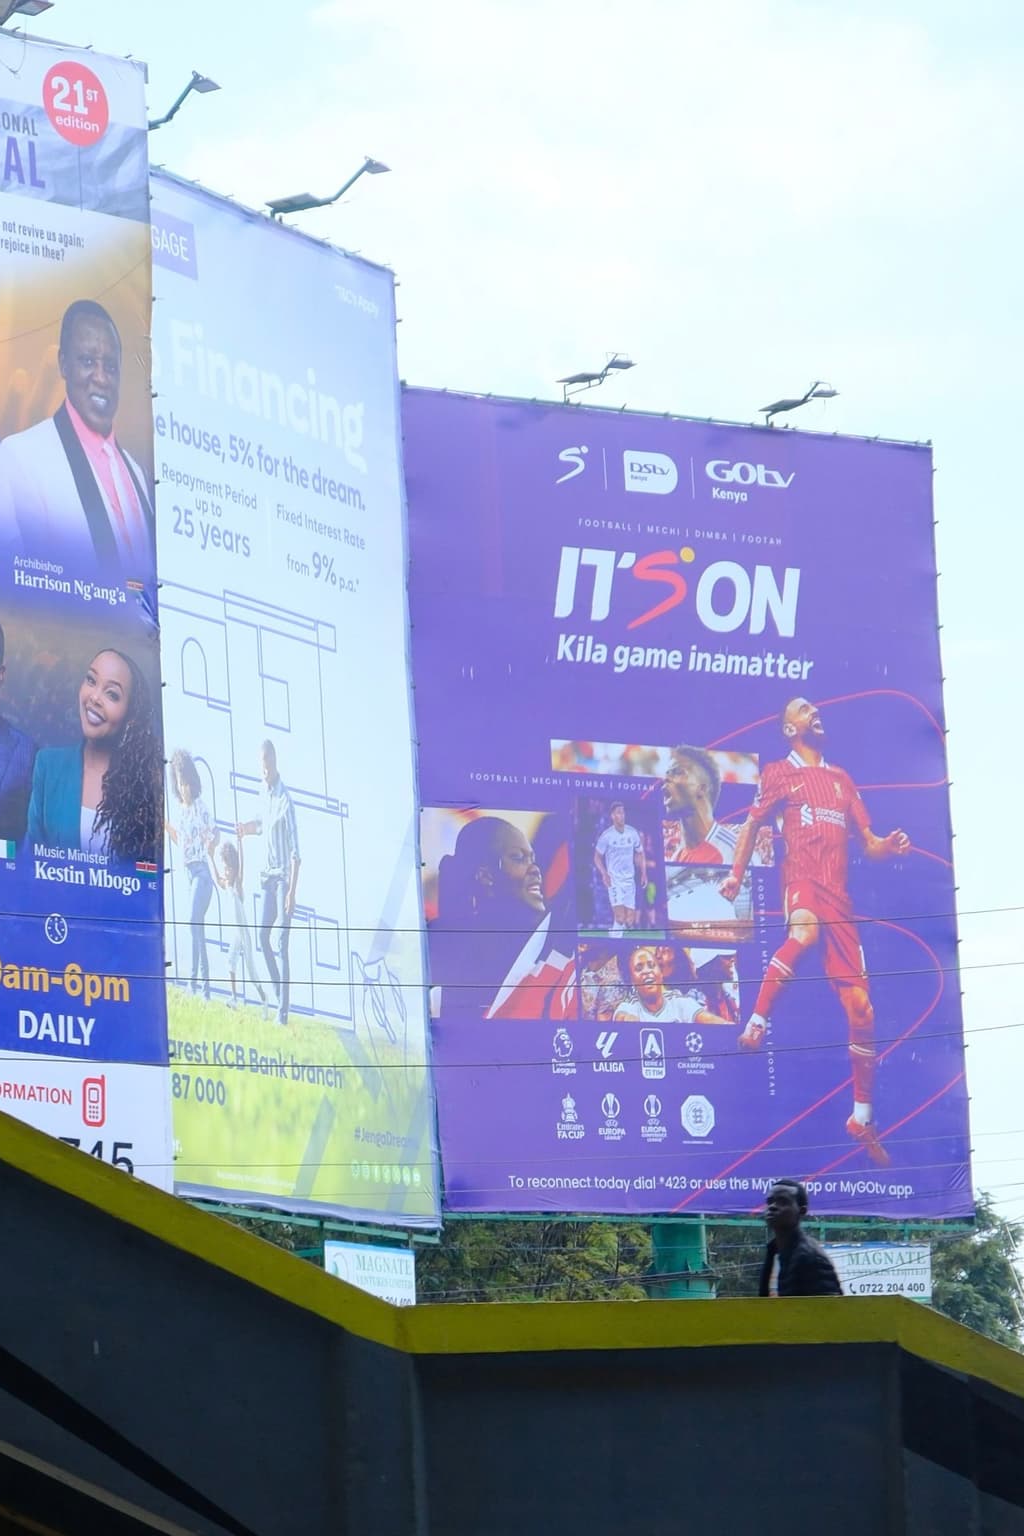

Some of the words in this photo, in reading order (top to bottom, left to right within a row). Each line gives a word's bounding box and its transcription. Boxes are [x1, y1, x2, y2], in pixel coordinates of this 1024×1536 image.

[55, 114, 100, 134] edition
[2, 220, 17, 234] not
[18, 224, 45, 240] revive
[46, 231, 57, 243] us
[0, 238, 30, 254] rejoice
[31, 242, 40, 256] in
[41, 245, 65, 262] thee?
[169, 318, 369, 475] Financing
[168, 411, 227, 464] house,
[228, 433, 255, 470] 5%
[256, 444, 280, 479] for
[282, 456, 310, 489] the
[311, 467, 367, 512] dream.
[161, 462, 223, 499] Repayment
[224, 484, 258, 510] Period
[705, 459, 796, 489] GOtv
[195, 497, 209, 516] up
[210, 502, 223, 518] to
[712, 487, 749, 504] Kenya
[172, 505, 195, 539] 25
[199, 520, 251, 559] years
[276, 503, 304, 528] Fixed
[304, 513, 342, 543] Interest
[342, 528, 366, 551] Rate
[578, 517, 632, 532] FOOTBALL
[647, 525, 681, 537] MECHI
[694, 529, 728, 541] DIMBA
[286, 553, 311, 577] from
[311, 551, 337, 586] 9%
[13, 568, 71, 594] Harrison
[73, 579, 127, 606] Ng'ang'a
[553, 546, 689, 630] IT'S
[695, 560, 801, 638] ON
[556, 634, 608, 664] Kila
[613, 643, 683, 673] game
[688, 645, 815, 681] inamatter
[469, 772, 520, 784] FOOTBALL
[5, 862, 17, 871] NG
[33, 843, 66, 860] Music
[67, 845, 110, 866] Minister
[33, 860, 86, 884] Kestin
[87, 867, 142, 895] Mbogo
[147, 881, 158, 890] KE
[18, 1009, 96, 1046] DAILY
[212, 1041, 246, 1070] KCB
[248, 1048, 288, 1080] Bank
[290, 1056, 344, 1089] branch
[592, 1061, 626, 1073] LALIGA
[171, 1072, 192, 1100] 87
[194, 1075, 227, 1106] 000
[557, 1131, 569, 1139] FA
[569, 1131, 585, 1140] CUP
[598, 1127, 627, 1137] EUROPA
[508, 1175, 525, 1189] To
[527, 1175, 591, 1189] reconnect
[594, 1176, 631, 1192] today
[633, 1175, 657, 1190] dial
[689, 1179, 703, 1190] or
[704, 1179, 727, 1190] use
[729, 1177, 749, 1190] the
[824, 1181, 837, 1193] or
[840, 1180, 886, 1196] MyGOtv
[888, 1184, 915, 1200] app.
[355, 1254, 413, 1276] MAGNATE
[846, 1250, 926, 1267] MAGNATE
[859, 1282, 884, 1294] 0722
[886, 1282, 905, 1293] 204
[906, 1282, 926, 1293] 400
